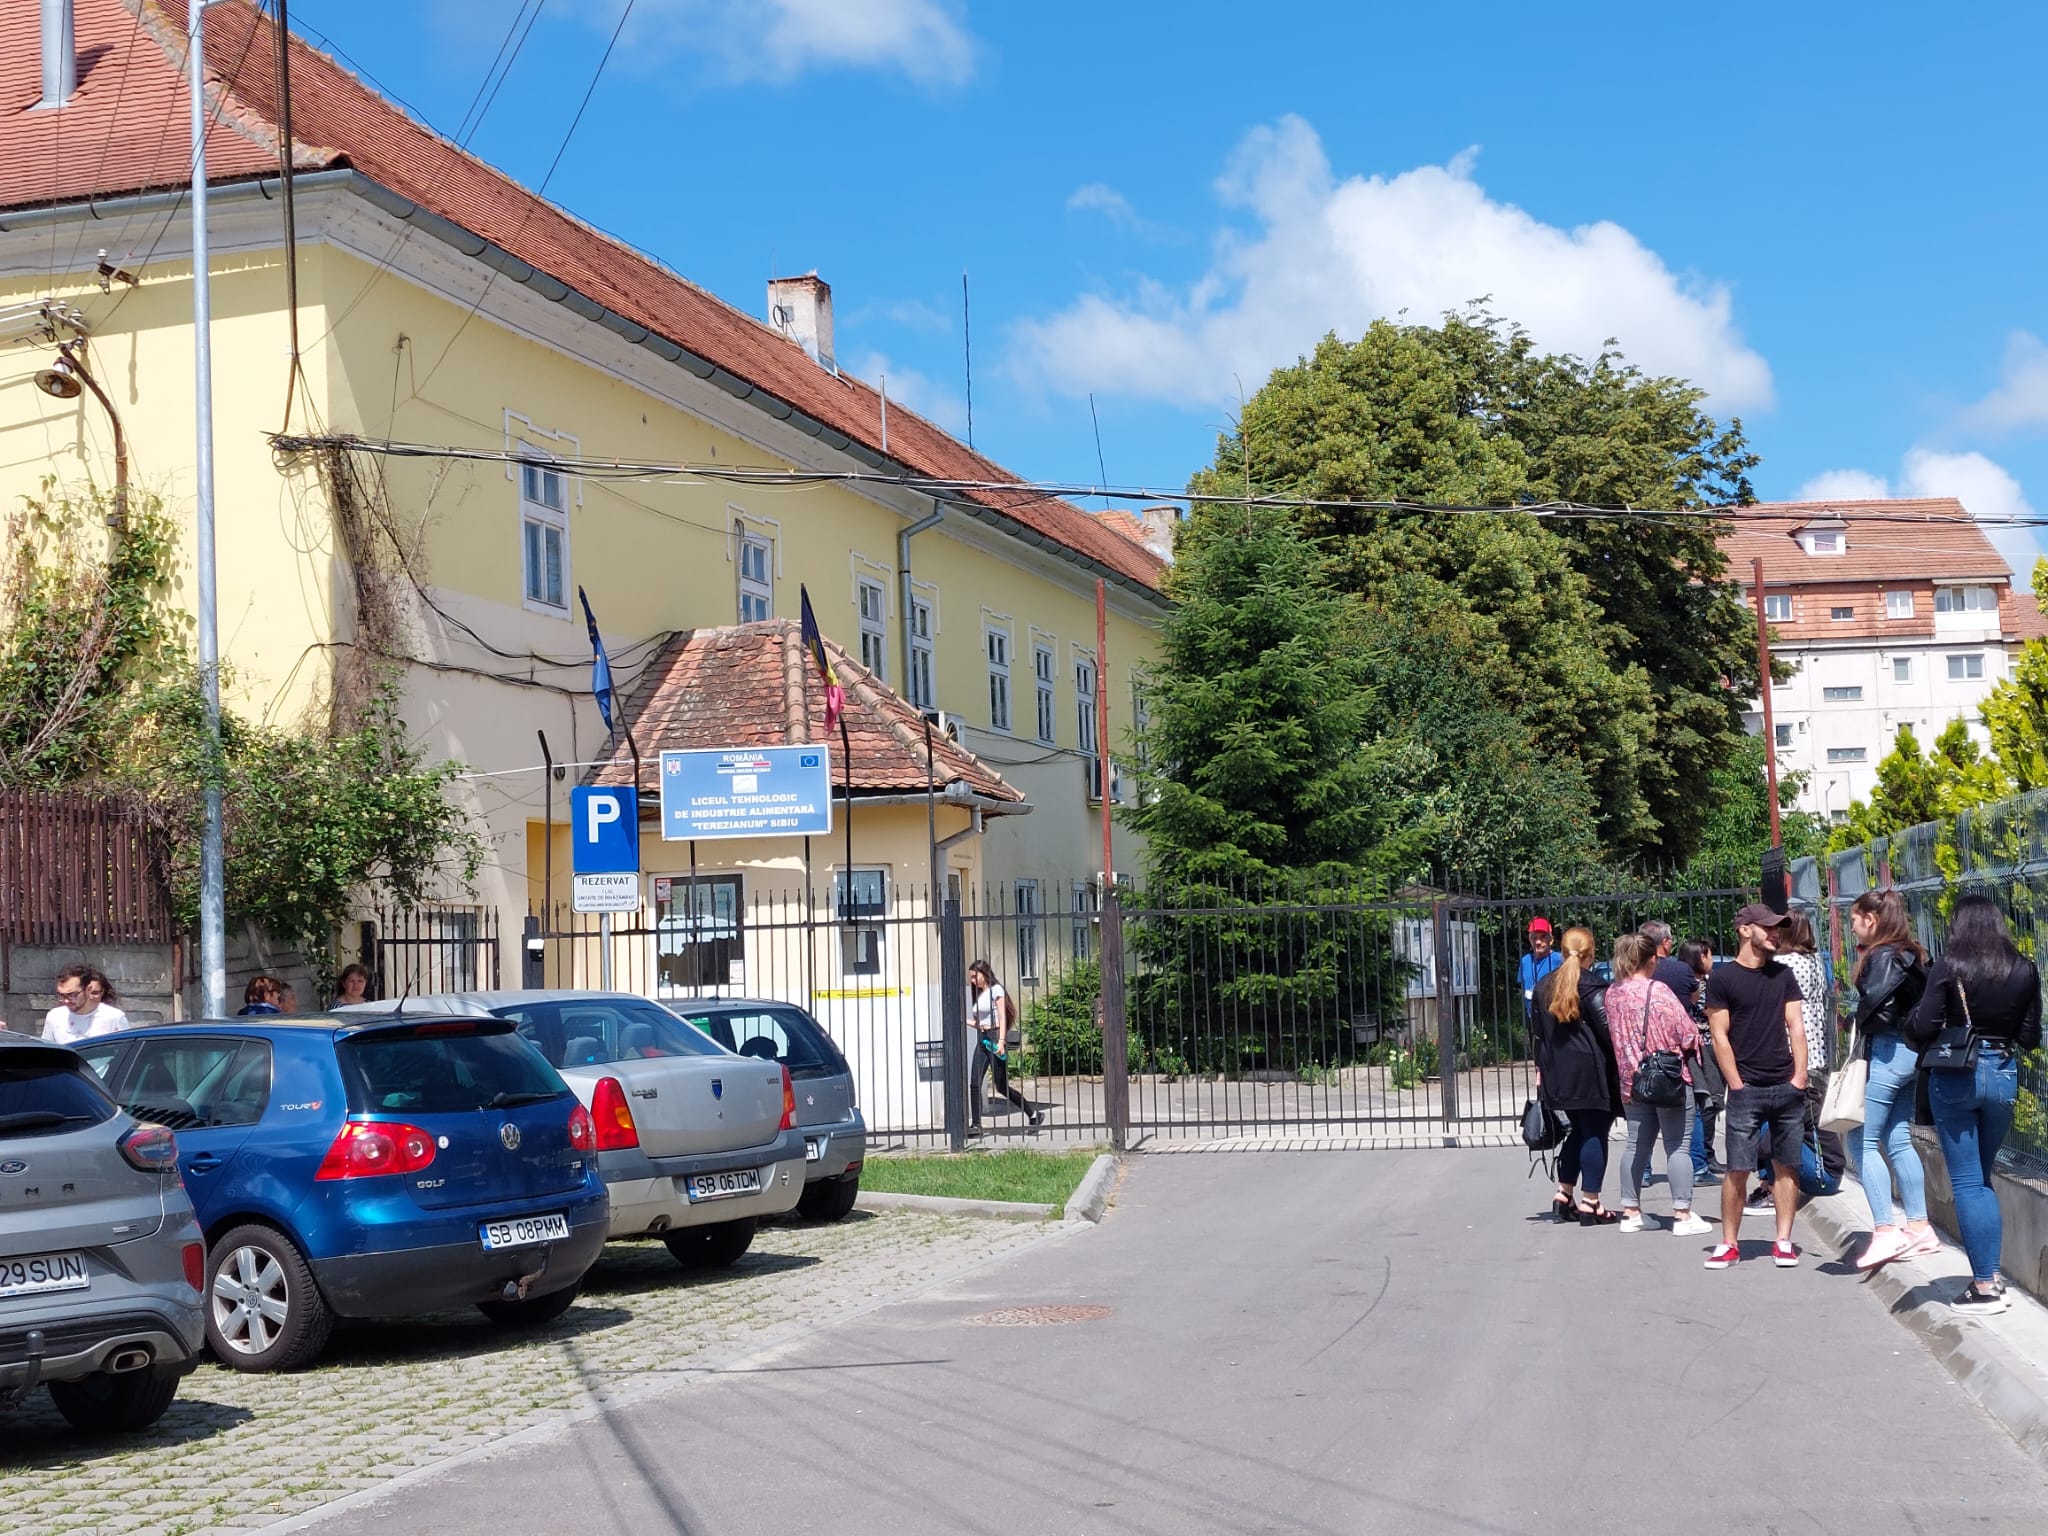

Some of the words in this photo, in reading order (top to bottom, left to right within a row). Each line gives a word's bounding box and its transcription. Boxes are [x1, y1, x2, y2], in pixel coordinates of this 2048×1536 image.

[723, 753, 764, 762] ROMÂNIA
[691, 796, 728, 806] LICEUL
[731, 794, 798, 804] TEHNOLOGIC
[588, 795, 620, 843] P
[674, 810, 688, 819] DE
[691, 808, 747, 818] INDUSTRIE
[770, 818, 799, 827] SIBIU
[581, 877, 630, 886] REZERVAT
[417, 1179, 446, 1189] GOLF
[697, 1176, 716, 1194] SB
[489, 1224, 512, 1245] SB
